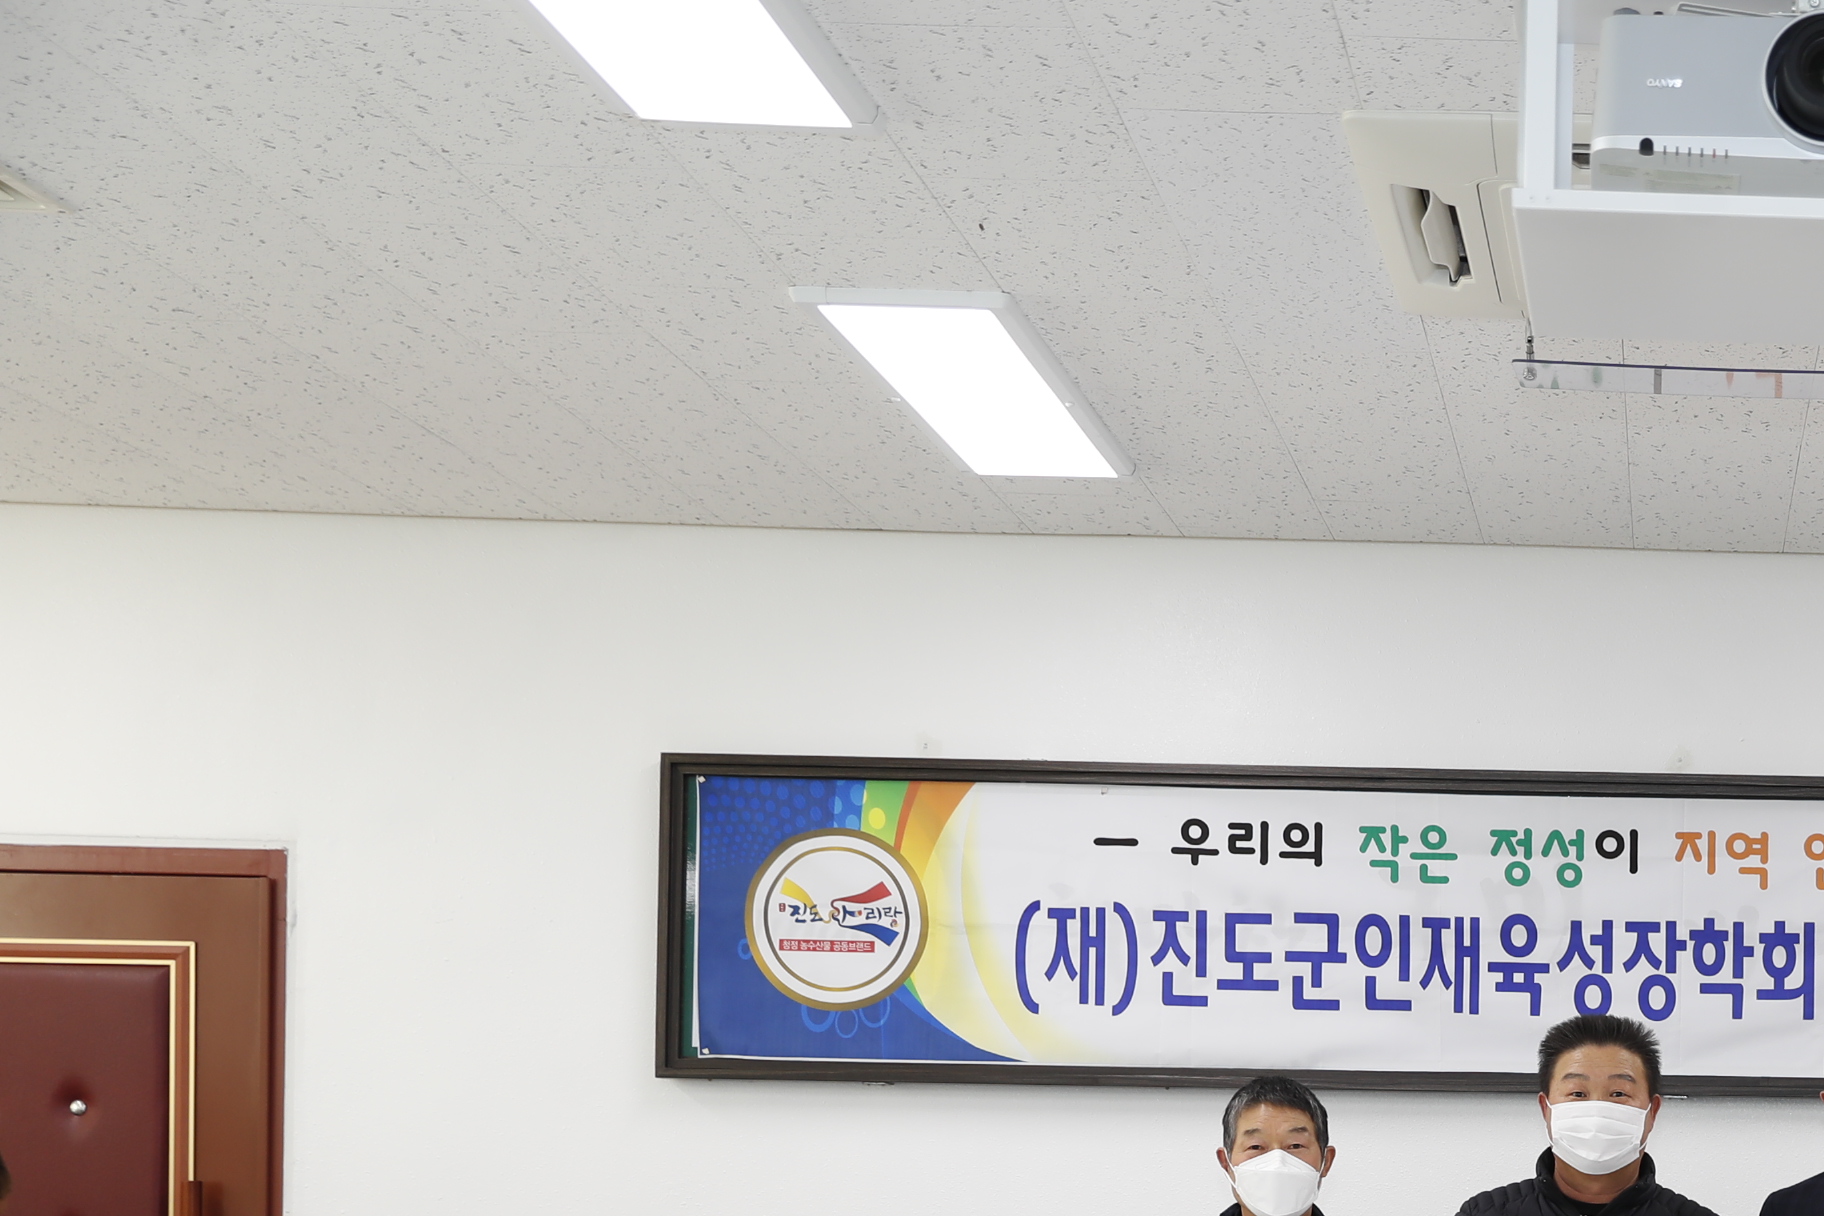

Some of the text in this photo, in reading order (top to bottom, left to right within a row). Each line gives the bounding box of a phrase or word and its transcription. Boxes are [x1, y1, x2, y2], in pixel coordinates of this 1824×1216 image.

[1170, 817, 1324, 868] 우리의
[1358, 824, 1459, 885] 작은
[1489, 827, 1639, 889] 정성이
[1674, 829, 1770, 891] 지역
[1014, 899, 1816, 1022] (재)진도군인재육성장학회
